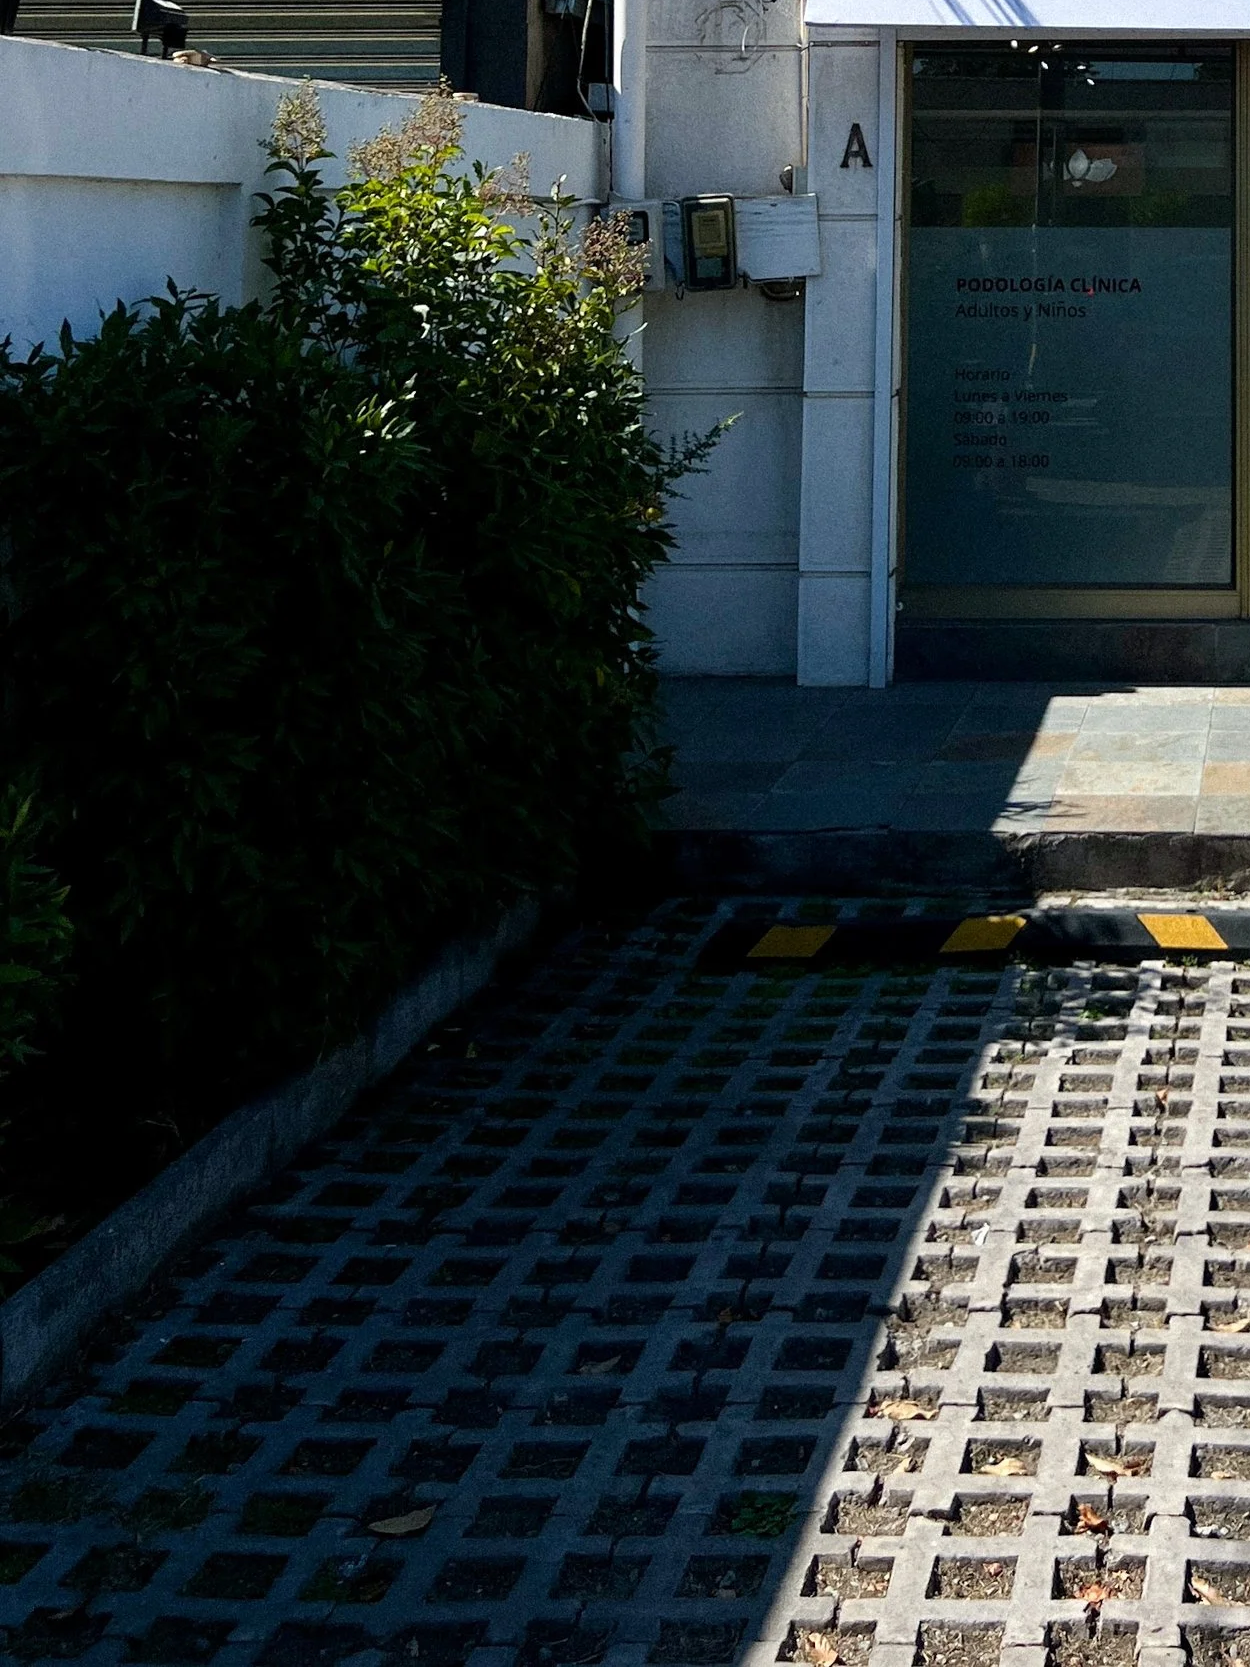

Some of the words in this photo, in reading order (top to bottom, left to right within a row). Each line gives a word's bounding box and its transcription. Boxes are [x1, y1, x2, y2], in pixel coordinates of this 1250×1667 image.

[839, 122, 874, 169] A
[956, 274, 1065, 293] PODOLOGÍA
[1070, 274, 1142, 293] CLÍNICA
[955, 302, 1022, 319] Adultos
[1023, 305, 1034, 322] y
[1039, 300, 1087, 319] Niños
